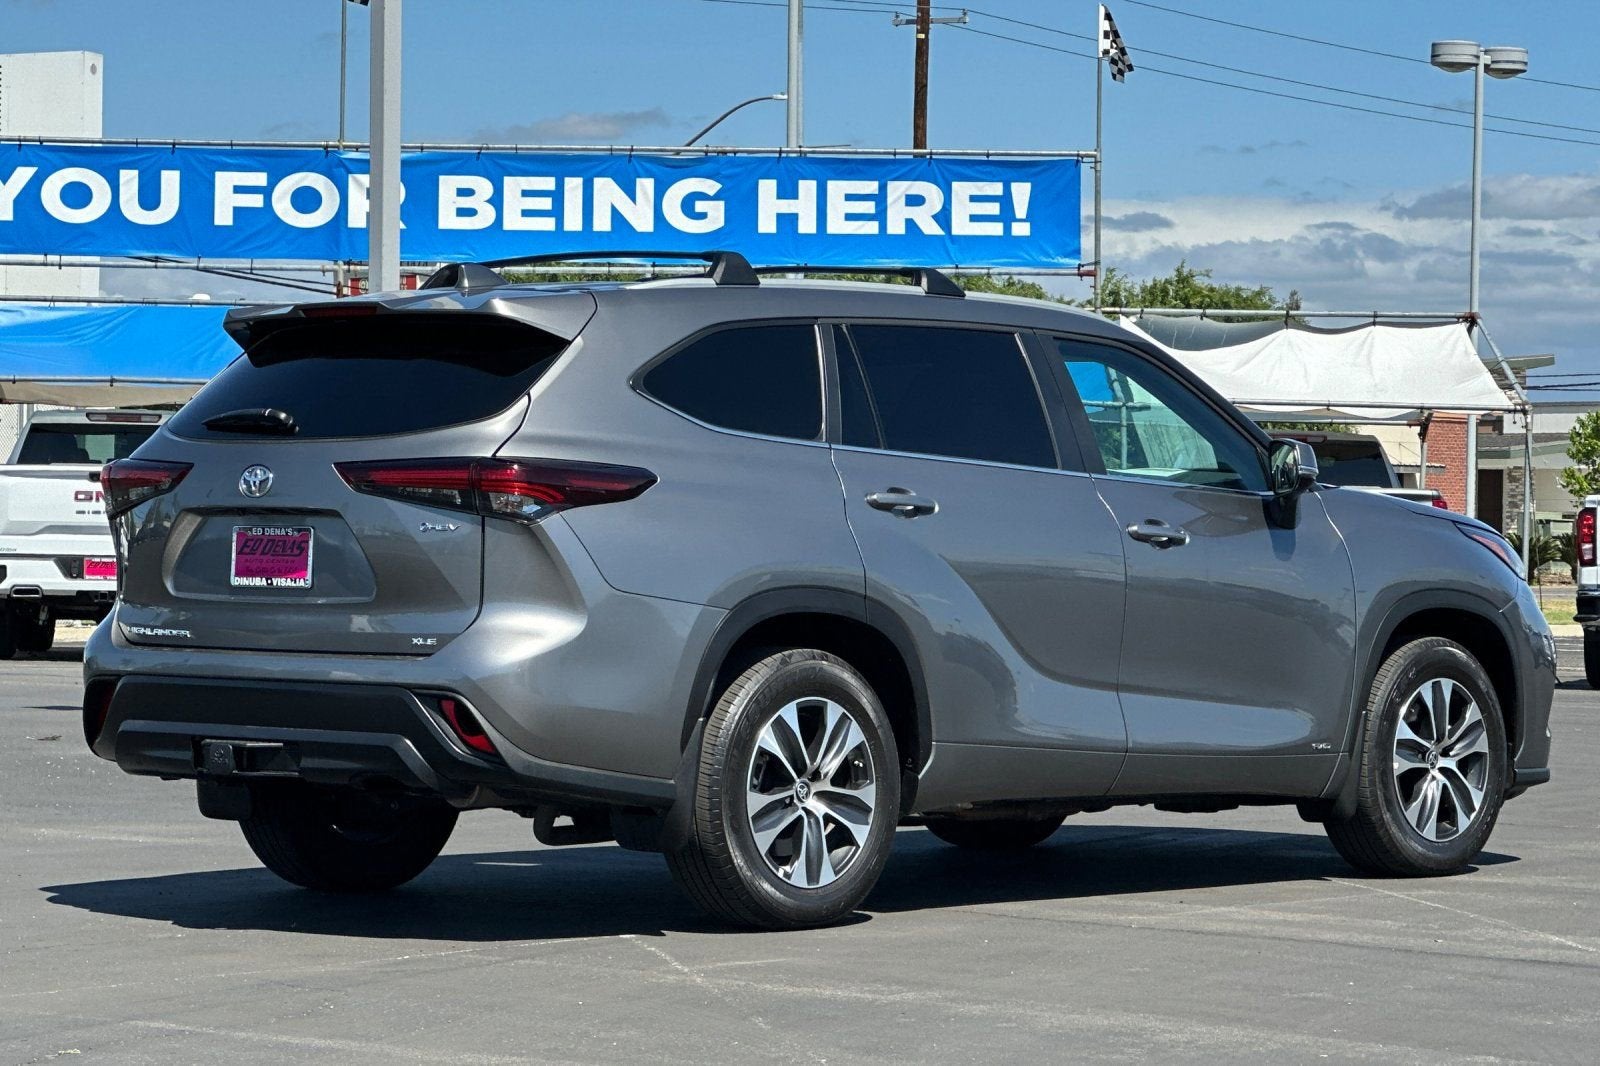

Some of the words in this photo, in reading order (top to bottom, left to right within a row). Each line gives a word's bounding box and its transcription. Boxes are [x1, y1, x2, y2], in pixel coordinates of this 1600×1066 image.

[0, 166, 180, 225] YOU
[213, 171, 407, 229] FOR
[438, 175, 725, 233] BEING
[757, 179, 1031, 236] HERE!
[252, 527, 263, 536] ED
[264, 527, 293, 536] DENA'S
[234, 576, 267, 586] DINUBA
[271, 577, 305, 587] VISALIA
